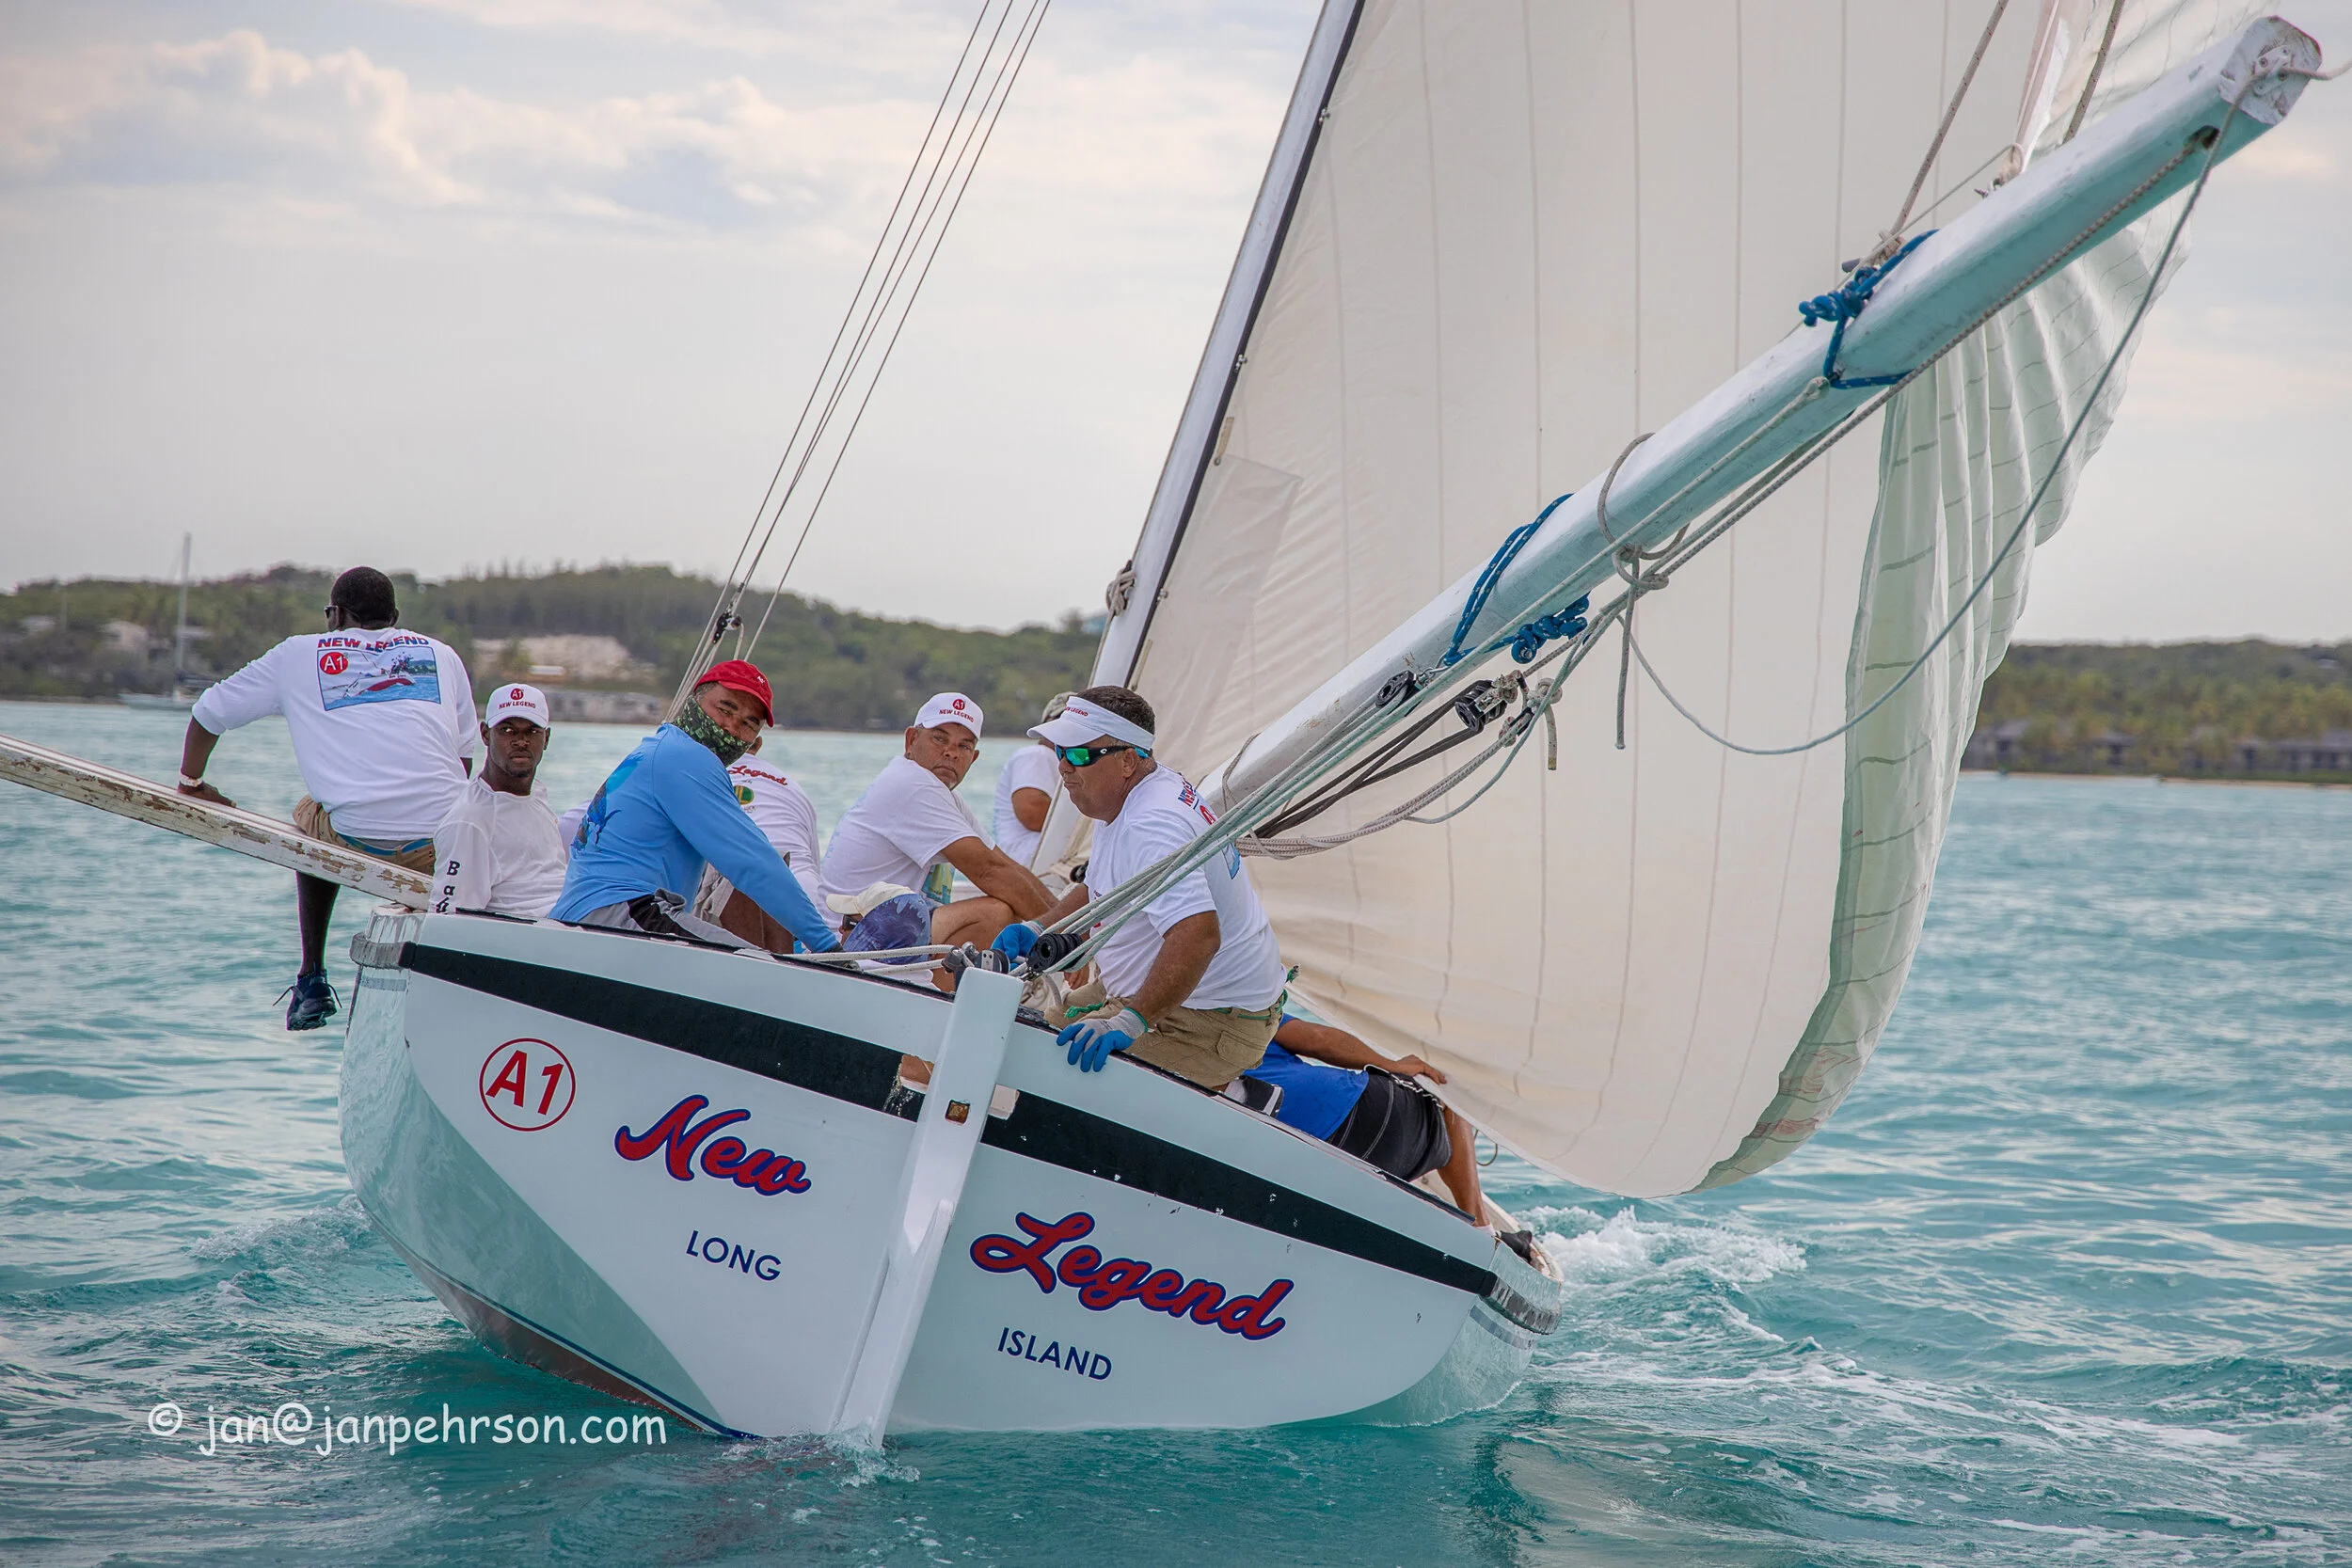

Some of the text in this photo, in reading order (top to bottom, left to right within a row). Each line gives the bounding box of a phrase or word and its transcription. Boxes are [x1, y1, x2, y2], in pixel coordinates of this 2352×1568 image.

[318, 638, 361, 648] NEW
[323, 655, 344, 672] A1
[499, 701, 536, 709] NEW LEGEND
[953, 710, 975, 722] LEGEND
[726, 766, 788, 785] Legend
[485, 1049, 564, 1116] A1
[614, 1094, 1295, 1340] New Legend
[686, 1229, 1112, 1381] LONG ISLAND
